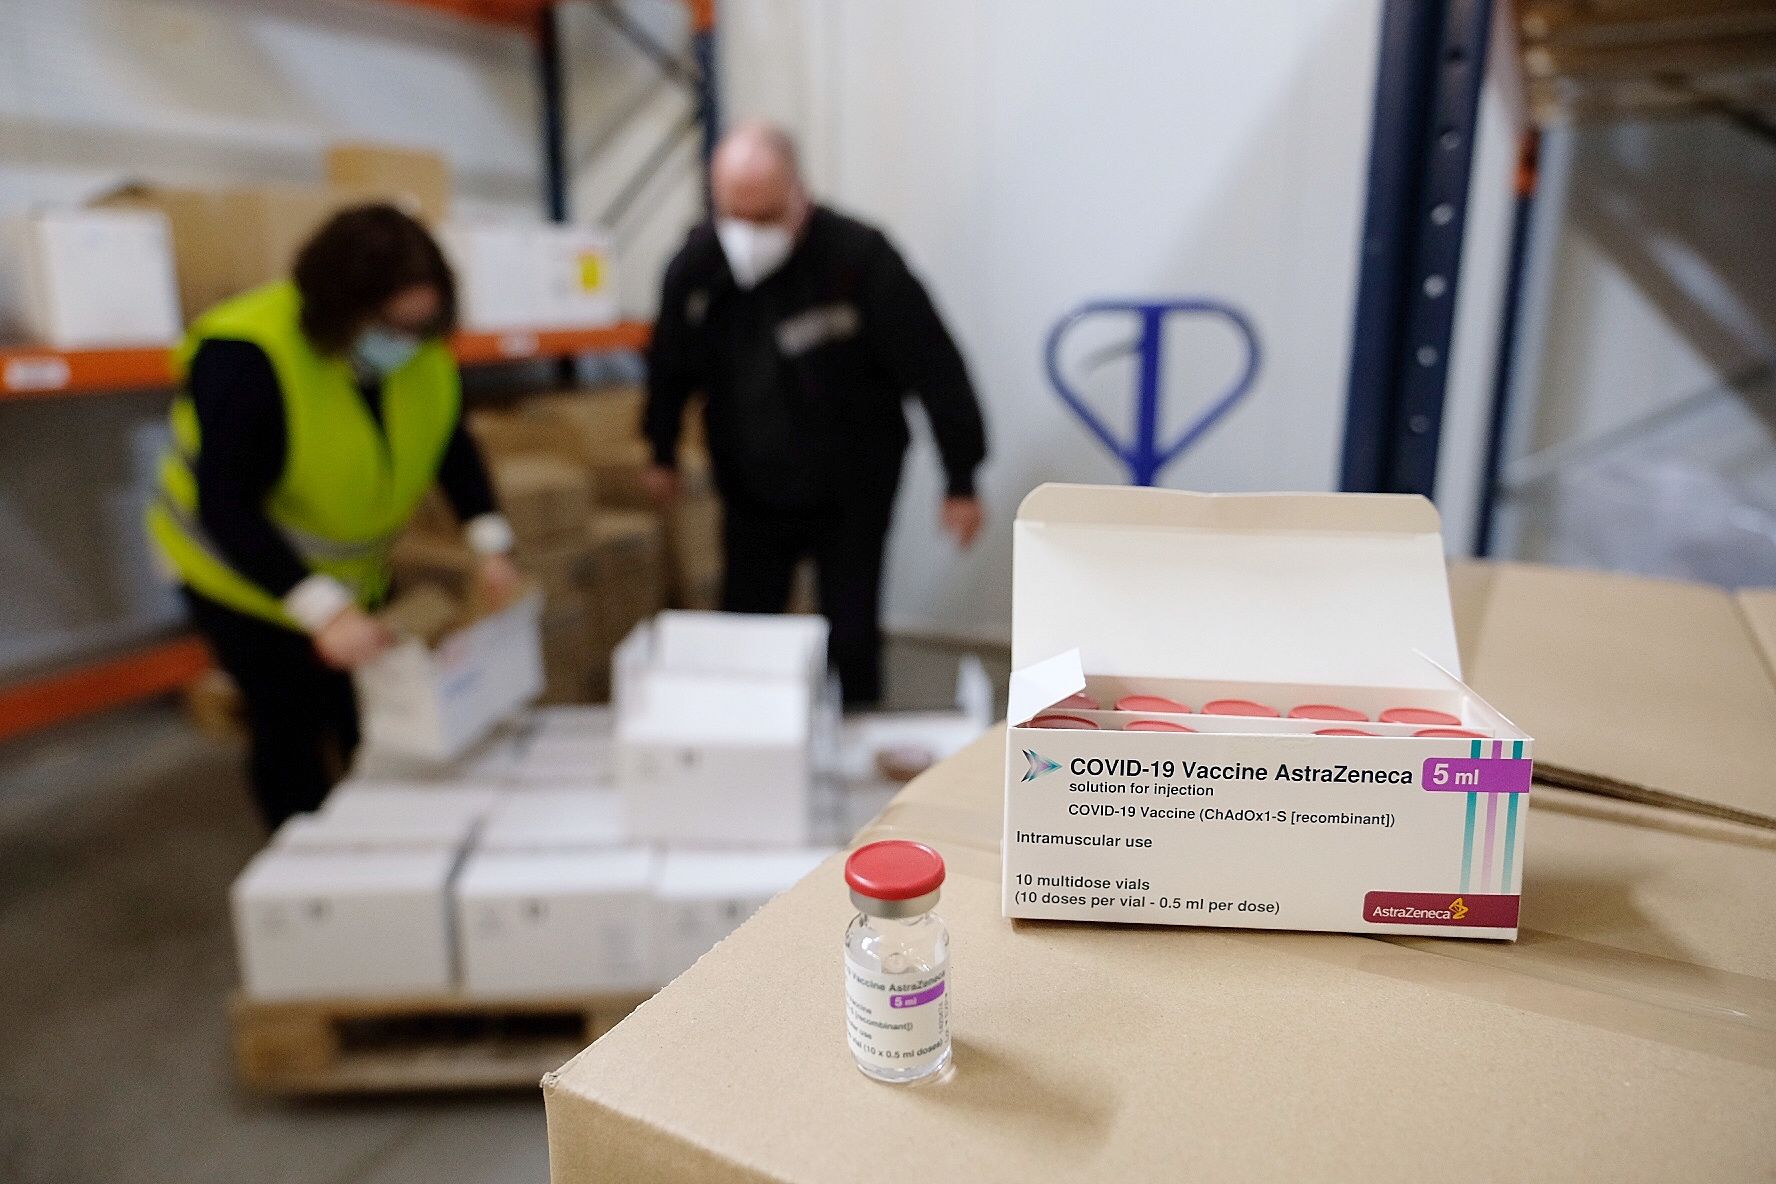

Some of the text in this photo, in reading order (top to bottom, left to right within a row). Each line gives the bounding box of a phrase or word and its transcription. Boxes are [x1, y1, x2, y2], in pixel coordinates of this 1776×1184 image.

[1069, 757, 1414, 785] COVID-19 Vaccine AstraZeneca
[1432, 763, 1480, 785] 5 ml
[1068, 781, 1214, 798] solution for injection
[1068, 803, 1396, 828] COVID-19 Vaccine (ChAdOx1-S [recombinant])
[1016, 830, 1153, 849] Intramuscular use
[1015, 873, 1150, 891] 10 multidose vials
[1014, 890, 1038, 906] (10
[1041, 891, 1087, 906] doses
[1090, 895, 1116, 909] per
[1119, 895, 1146, 908] vial
[1159, 896, 1182, 910] 0.5
[1185, 898, 1204, 910] ml
[1208, 900, 1234, 914] per
[1237, 899, 1280, 916] dose)
[1372, 905, 1450, 921] AstraZeneca
[894, 996, 918, 1007] 5 ml
[885, 1050, 900, 1059] 0.5
[902, 1050, 915, 1058] ml
